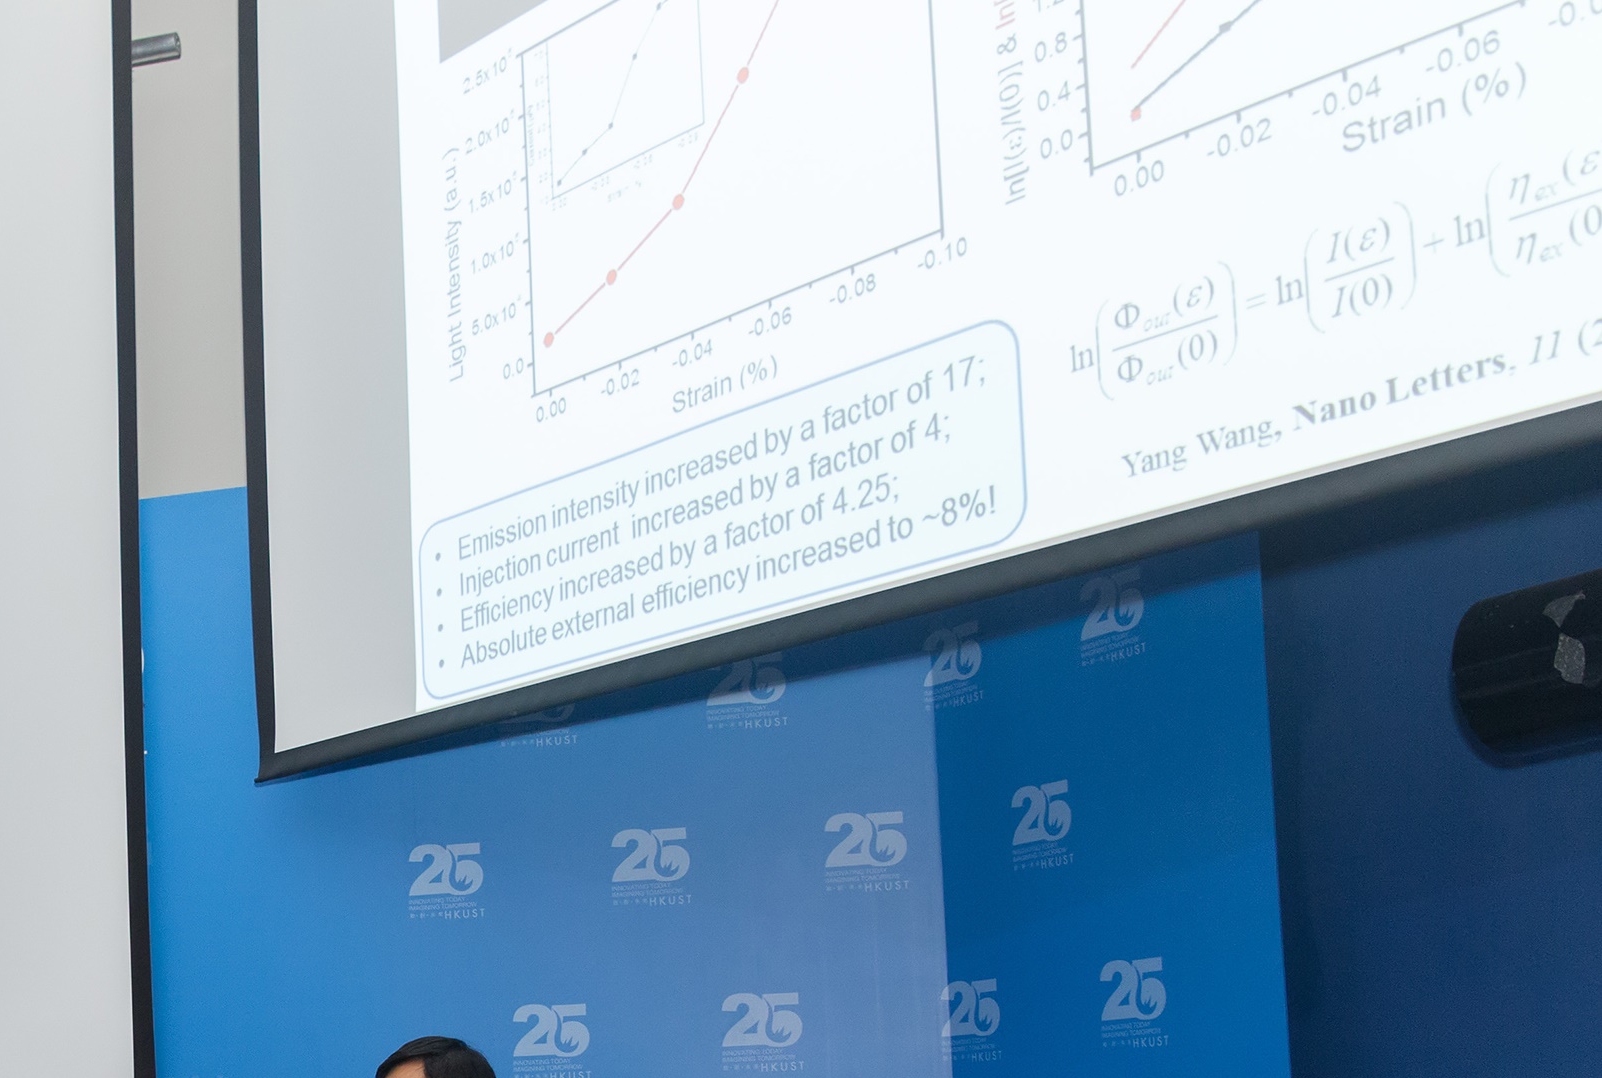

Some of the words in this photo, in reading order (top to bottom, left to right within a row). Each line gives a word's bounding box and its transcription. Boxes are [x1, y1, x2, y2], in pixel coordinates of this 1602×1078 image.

[1343, 93, 1447, 152] Strain
[1461, 62, 1527, 117] (%)
[671, 375, 734, 416] Strain
[739, 354, 779, 391] (%)
[1120, 444, 1188, 478] Yang
[1195, 420, 1283, 455] Wang,
[1292, 390, 1378, 431] Nano
[1385, 353, 1516, 405] Letters,
[457, 513, 548, 561] Emission
[551, 479, 641, 529] intensity
[644, 431, 759, 497] increased
[763, 425, 794, 457] by
[799, 418, 816, 443] a
[821, 388, 900, 435] factor
[906, 369, 934, 406] of
[943, 354, 986, 393] 17;
[460, 584, 555, 633] Efficiency
[558, 543, 665, 602] increased
[668, 539, 697, 570] by
[703, 533, 719, 557] a
[723, 508, 796, 550] factor
[800, 491, 826, 526] of
[831, 471, 900, 515] 4.25;
[460, 624, 548, 669] Absolute
[550, 592, 636, 641] external
[640, 563, 751, 615] efficiency
[755, 518, 882, 582] increased
[886, 514, 915, 544] to
[921, 483, 996, 528] ~8%!
[408, 842, 484, 896] 25
[824, 811, 908, 868] 25
[444, 908, 486, 919] HKUST
[864, 880, 910, 892] HKUST
[1100, 956, 1167, 1022] 25
[722, 992, 803, 1048] 25
[1133, 1035, 1169, 1048] HKUST
[760, 1060, 804, 1072] HKUST
